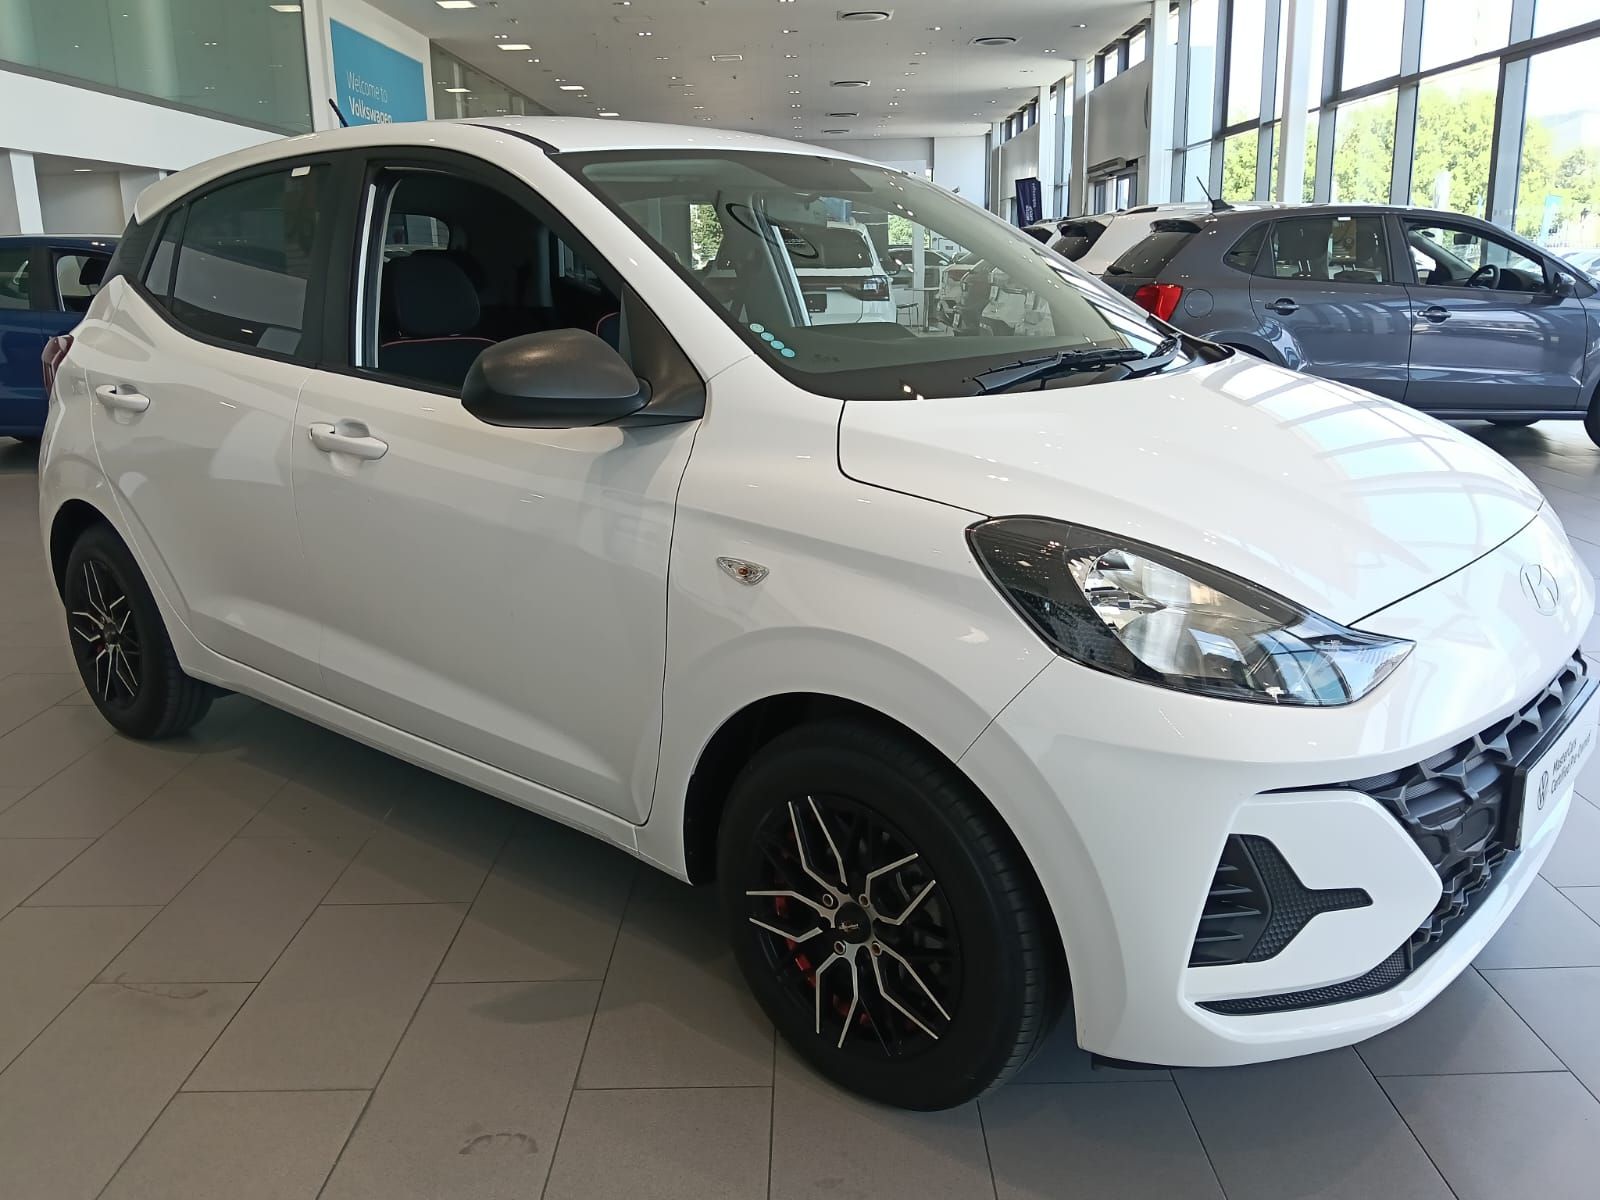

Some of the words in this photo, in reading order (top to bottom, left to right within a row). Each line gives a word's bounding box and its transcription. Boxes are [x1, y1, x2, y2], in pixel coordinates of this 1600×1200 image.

[347, 71, 380, 100] Welcome
[380, 87, 388, 104] to
[348, 95, 392, 124] Volkswagen
